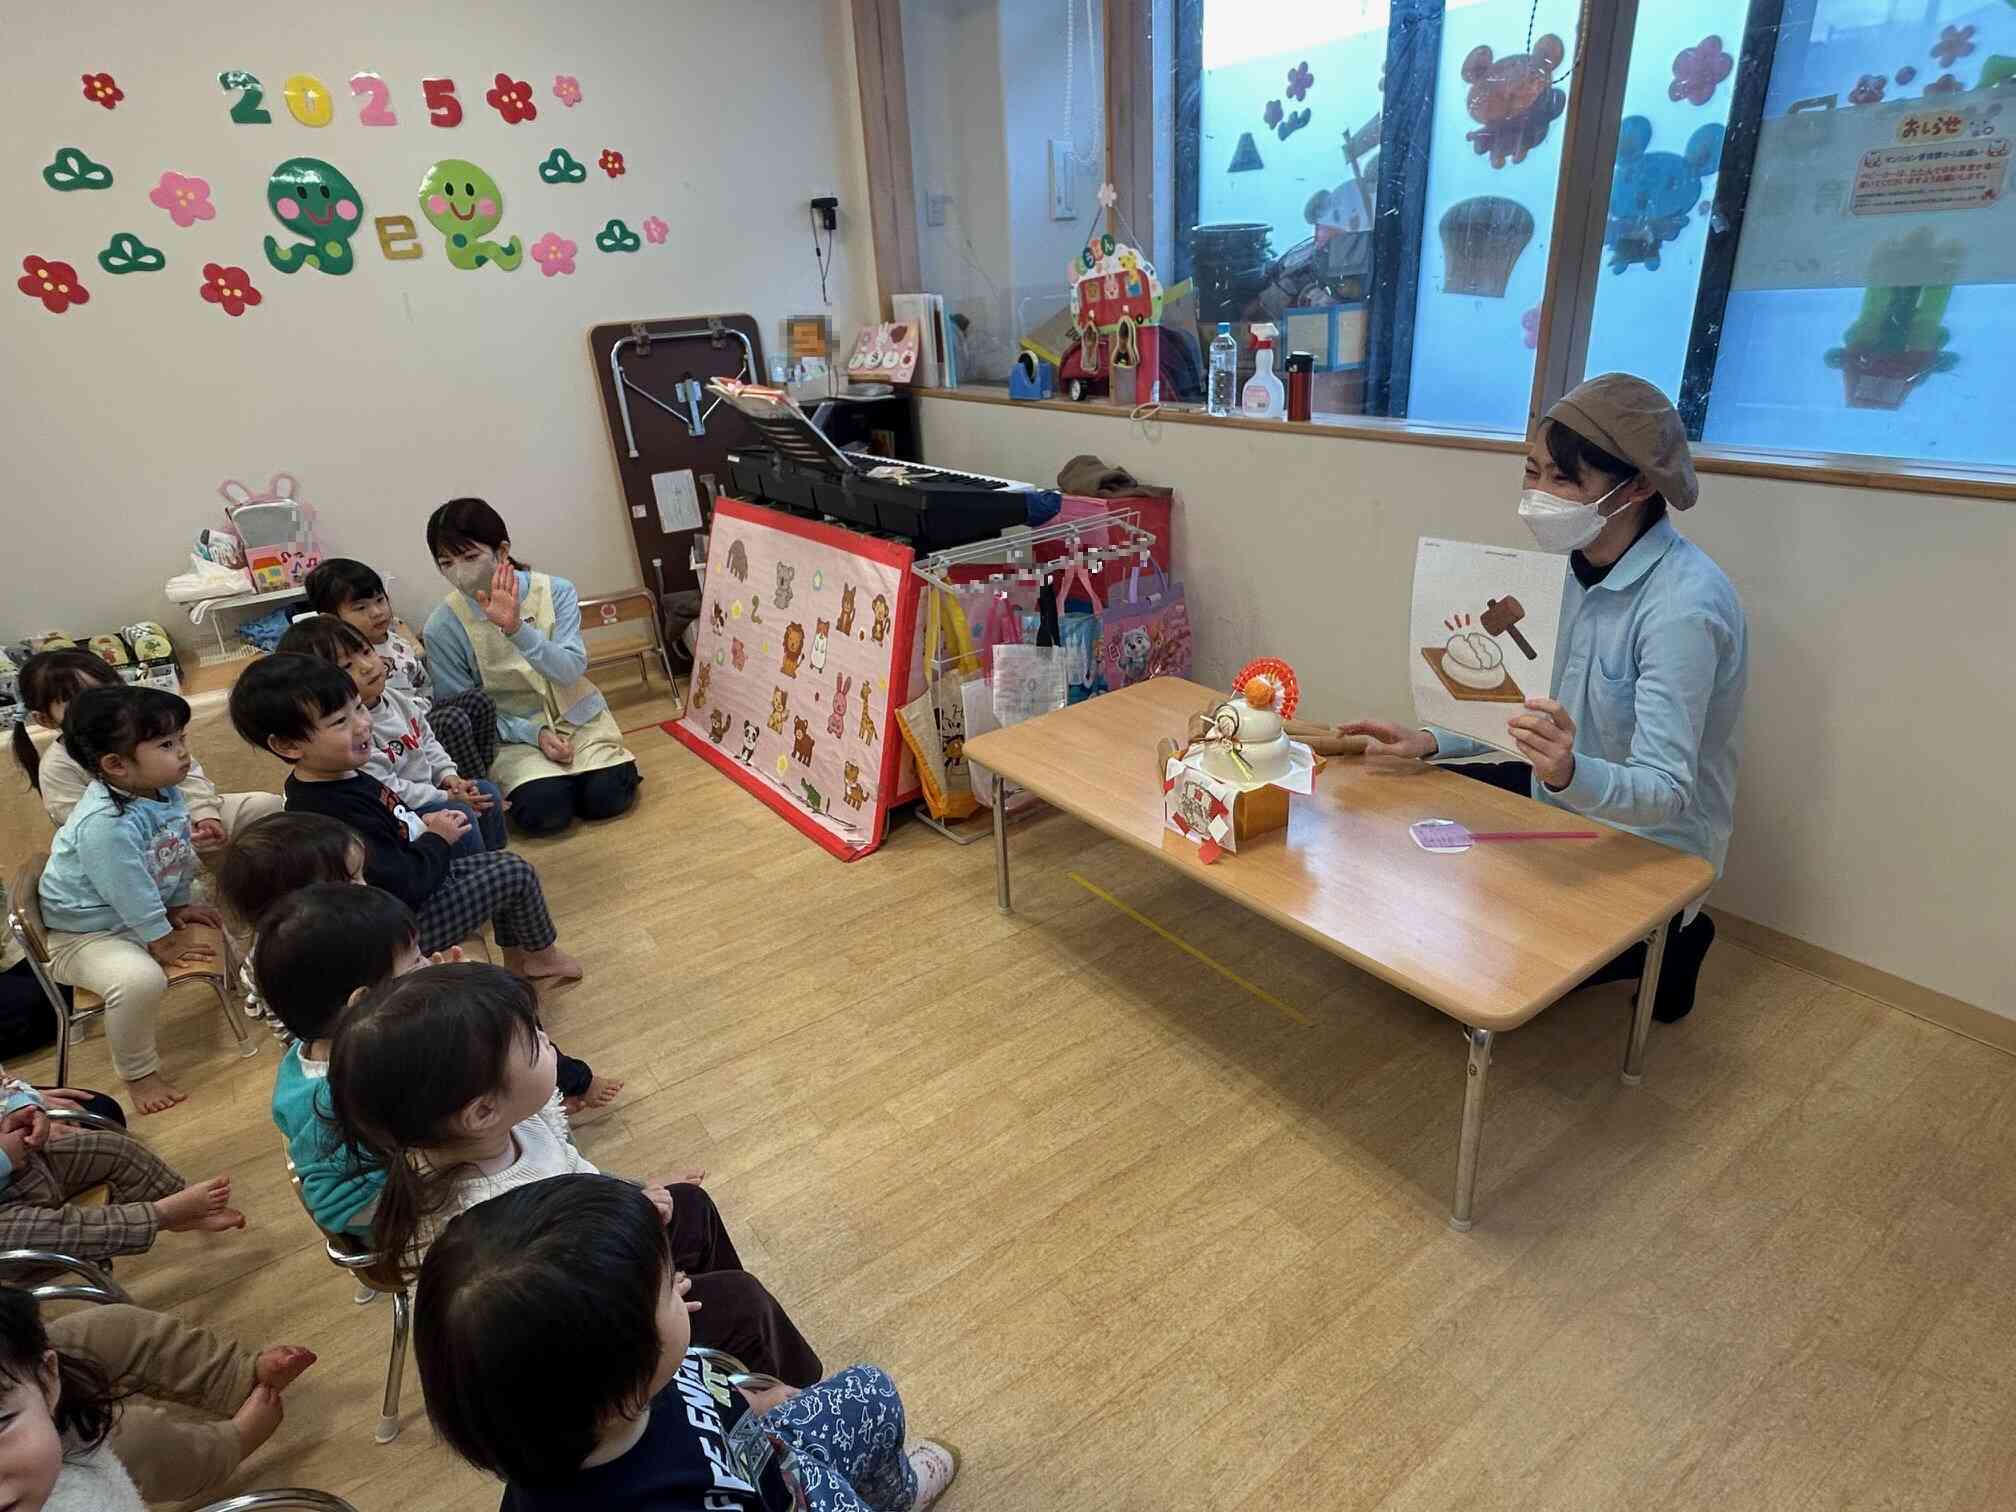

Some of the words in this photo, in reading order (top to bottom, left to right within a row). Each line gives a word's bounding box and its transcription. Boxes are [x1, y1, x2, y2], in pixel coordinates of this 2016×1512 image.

[217, 71, 463, 128] 2025
[1903, 113, 1962, 138] おしらせ
